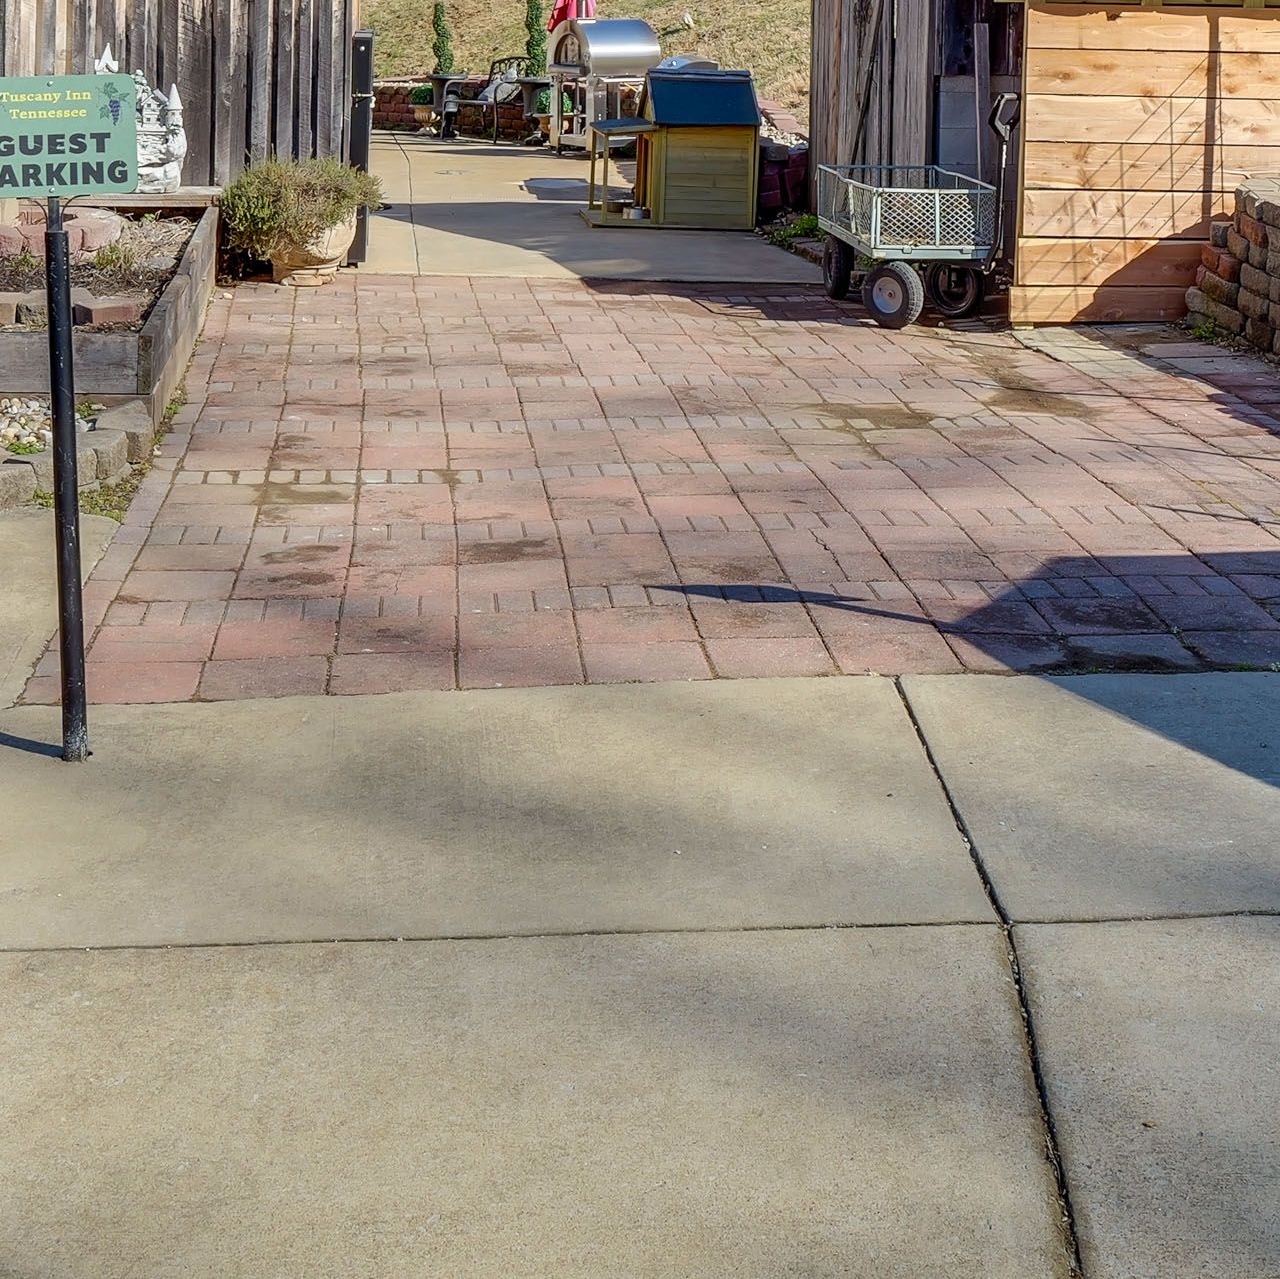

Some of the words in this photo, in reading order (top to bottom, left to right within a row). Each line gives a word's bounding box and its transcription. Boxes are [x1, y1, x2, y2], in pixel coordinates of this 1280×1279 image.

[0, 92, 61, 104] Tuscany
[65, 90, 92, 101] Inn
[9, 108, 87, 119] Tennessee
